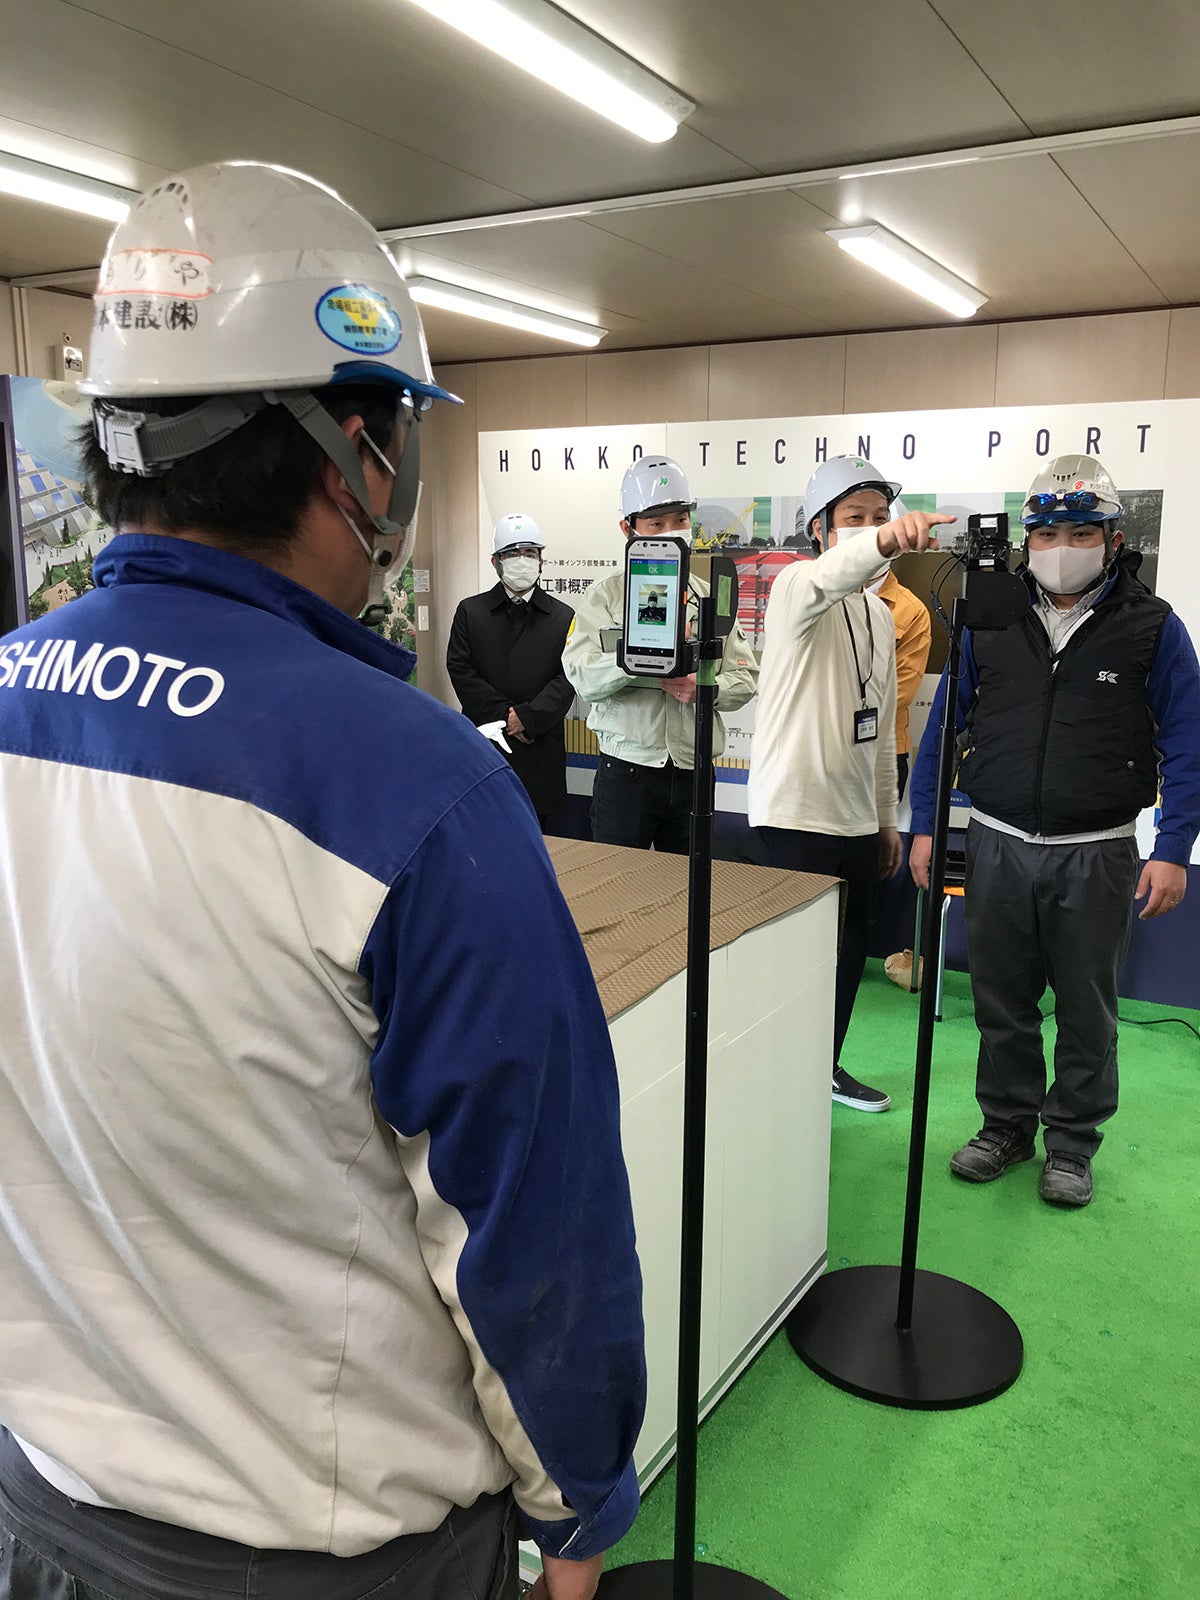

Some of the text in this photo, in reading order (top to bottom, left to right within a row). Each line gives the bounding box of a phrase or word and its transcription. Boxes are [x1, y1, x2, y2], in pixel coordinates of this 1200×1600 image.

[499, 424, 1152, 473] HOKKO TECHNO PORT
[648, 566, 658, 574] OK
[539, 578, 595, 594] 工事概要
